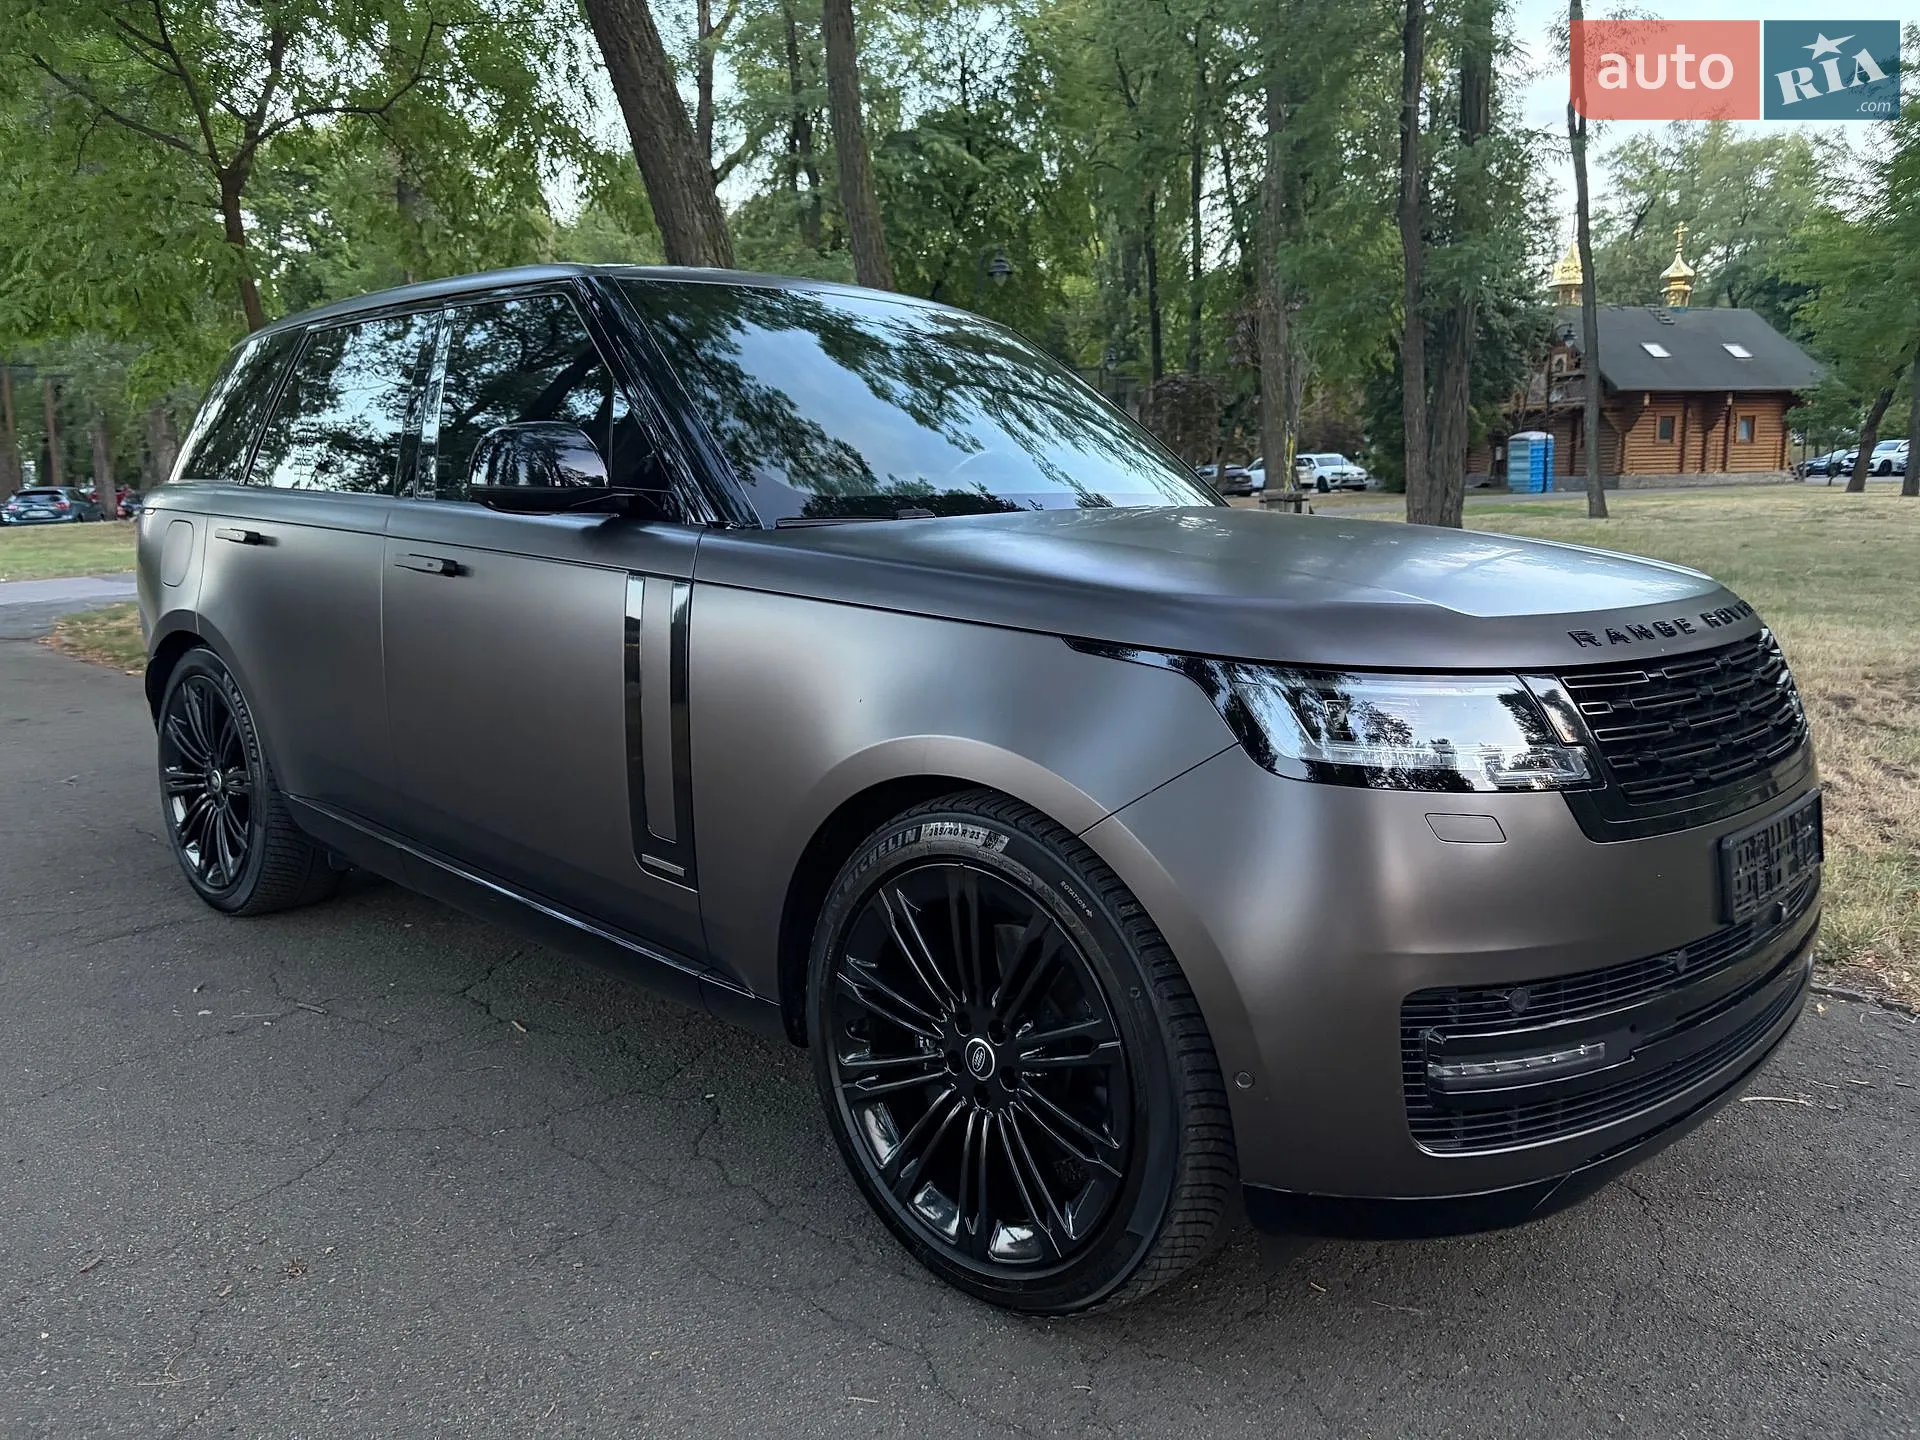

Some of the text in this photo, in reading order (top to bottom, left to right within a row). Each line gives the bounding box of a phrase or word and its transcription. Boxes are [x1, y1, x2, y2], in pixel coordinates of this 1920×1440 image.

[1567, 618, 1697, 648] RANGE
[843, 827, 917, 892] MICHELIN
[1059, 881, 1087, 910] ROTATION
